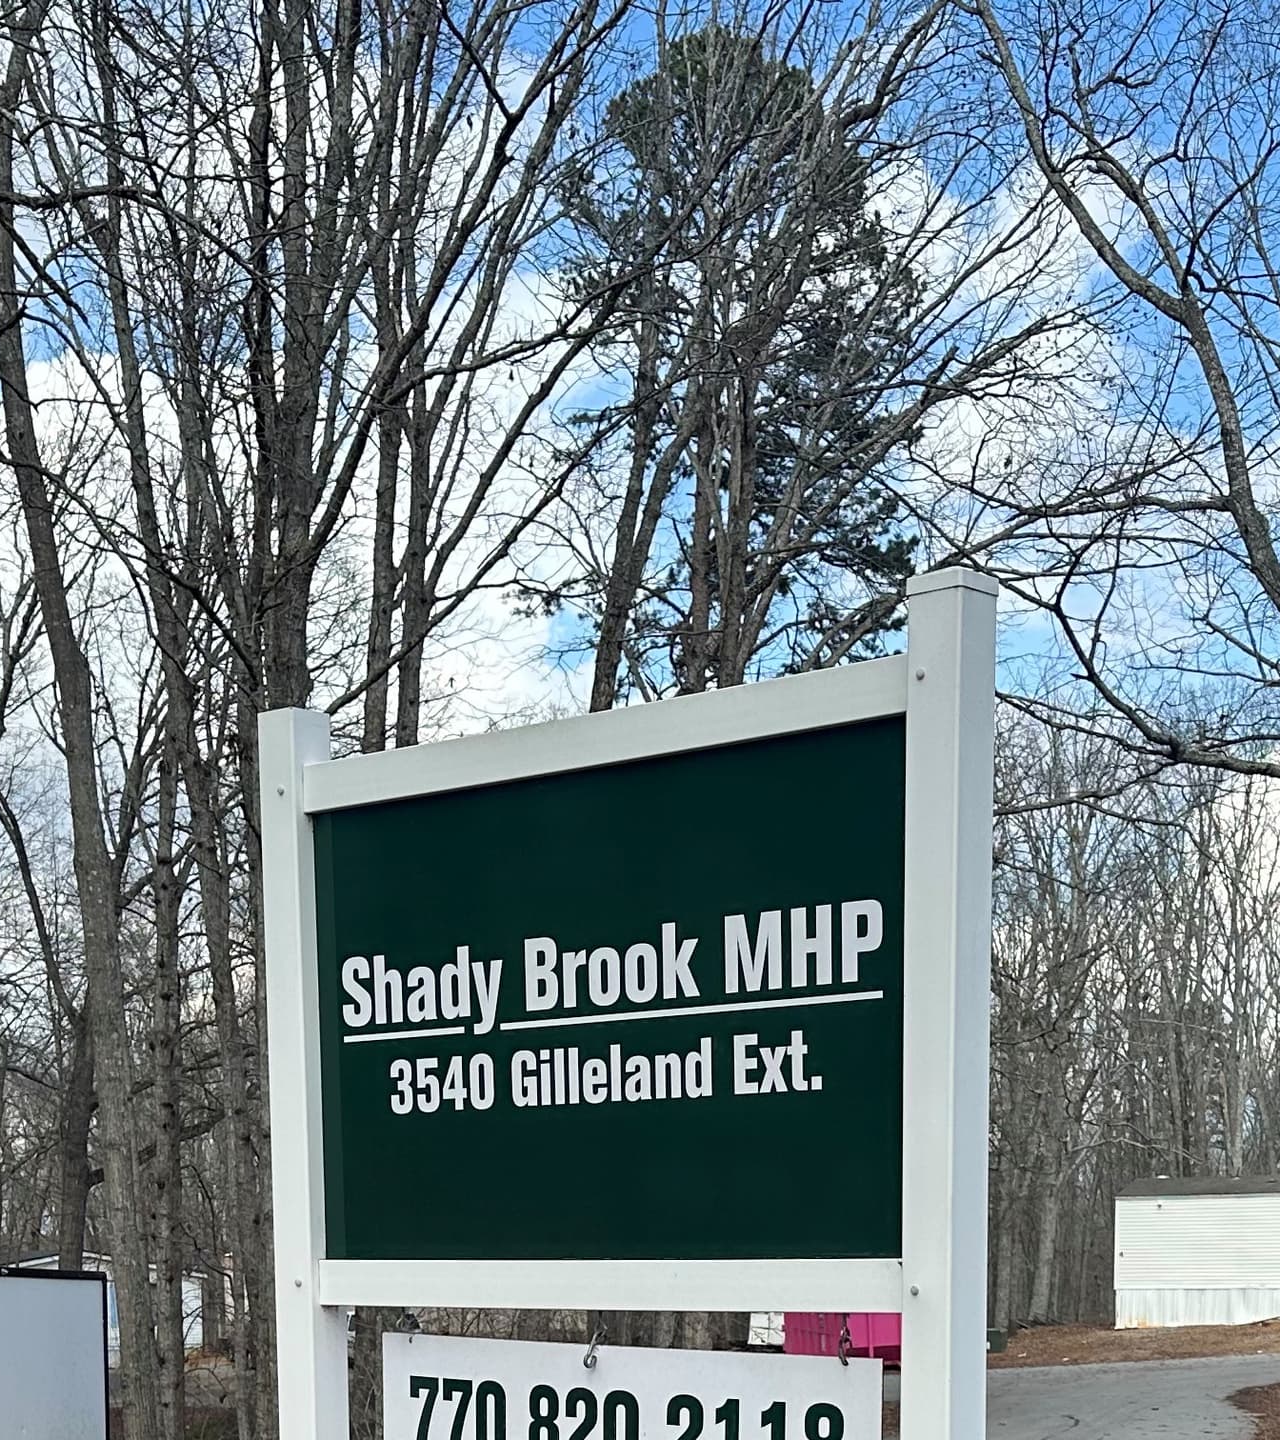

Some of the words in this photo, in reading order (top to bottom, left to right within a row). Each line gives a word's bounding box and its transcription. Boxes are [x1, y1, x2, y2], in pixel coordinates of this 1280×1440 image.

[342, 946, 502, 1035] Shady
[524, 922, 701, 1012] Brook
[724, 899, 884, 994] MHP
[390, 1052, 495, 1114] 3540
[512, 1036, 713, 1107] Gilleland
[733, 1030, 823, 1095] Ext.
